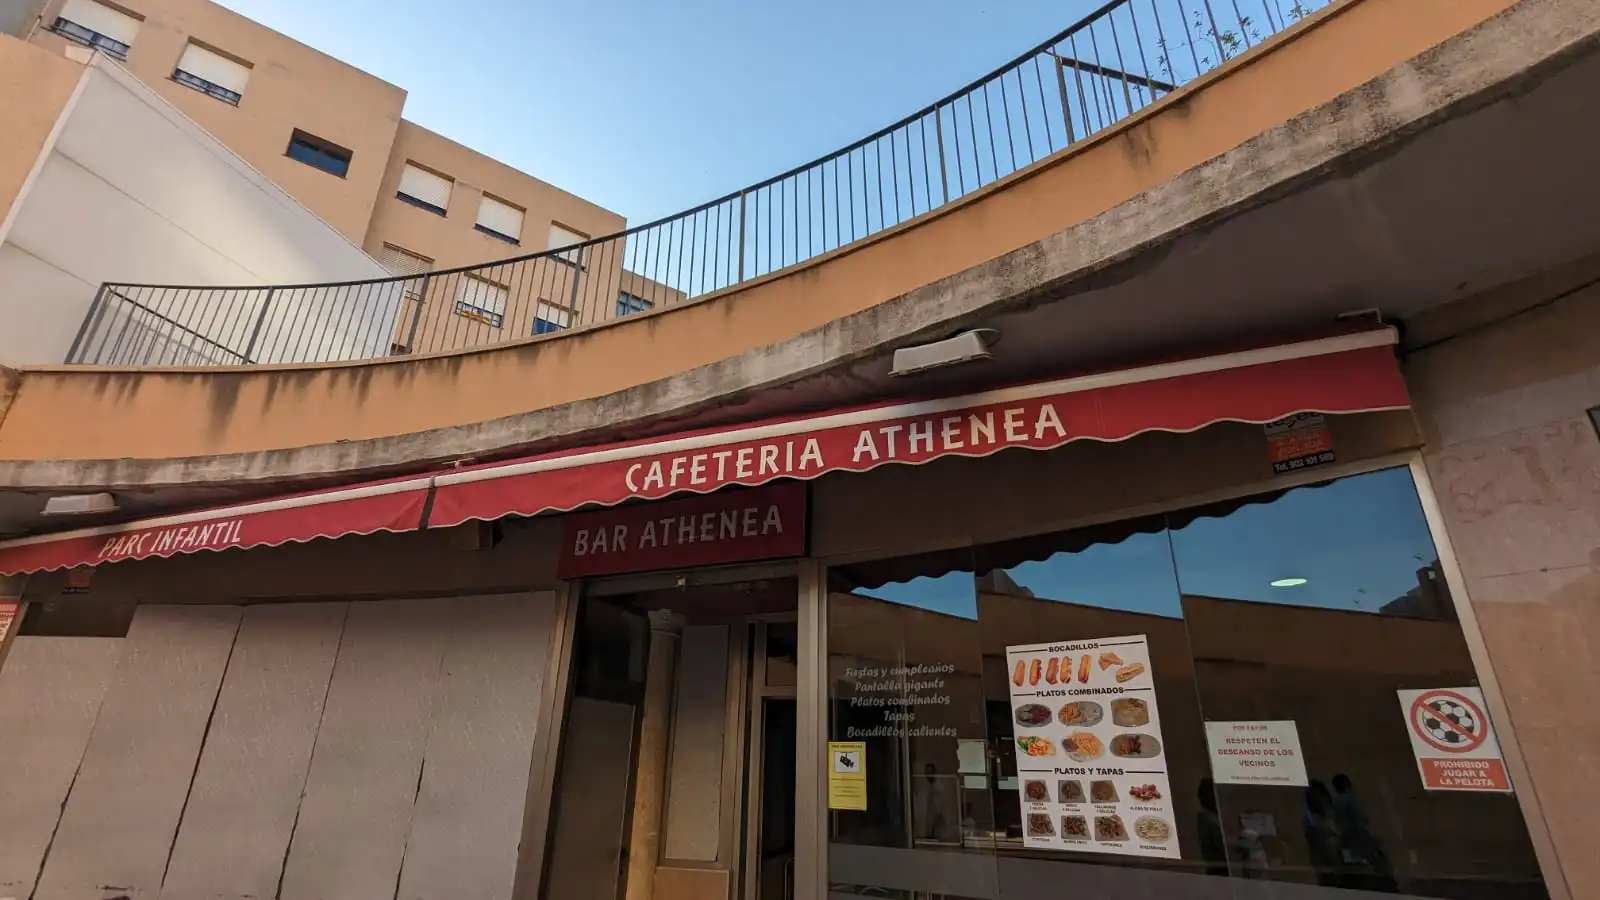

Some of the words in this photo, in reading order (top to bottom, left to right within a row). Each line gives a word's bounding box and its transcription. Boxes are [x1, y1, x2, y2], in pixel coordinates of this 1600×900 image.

[625, 438, 824, 492] CAFETERIA
[852, 403, 1067, 462] ATHENEA
[574, 524, 628, 556] BAR
[639, 505, 783, 549] ATHENEA
[99, 532, 150, 558] PARC
[150, 521, 242, 553] INFANTIL
[1048, 642, 1099, 653] BOCADILLOS
[845, 667, 879, 678] Fiestas
[881, 669, 887, 677] y
[890, 662, 954, 676] cumpleaños
[855, 680, 901, 692] Pantalla
[904, 679, 944, 693] gigante
[1036, 689, 1066, 697] PLATOS
[1068, 687, 1124, 696] COMBINADOS
[850, 697, 885, 707] Platos
[888, 694, 950, 705] combinados
[884, 710, 915, 721] Tapas
[847, 726, 904, 738] Bocadillos
[908, 725, 957, 737] calientes
[1054, 767, 1086, 775] PLATOS
[1096, 768, 1124, 776] TAPAS
[1434, 761, 1489, 769] PROHIBIDO
[1456, 778, 1494, 787] PELOTA
